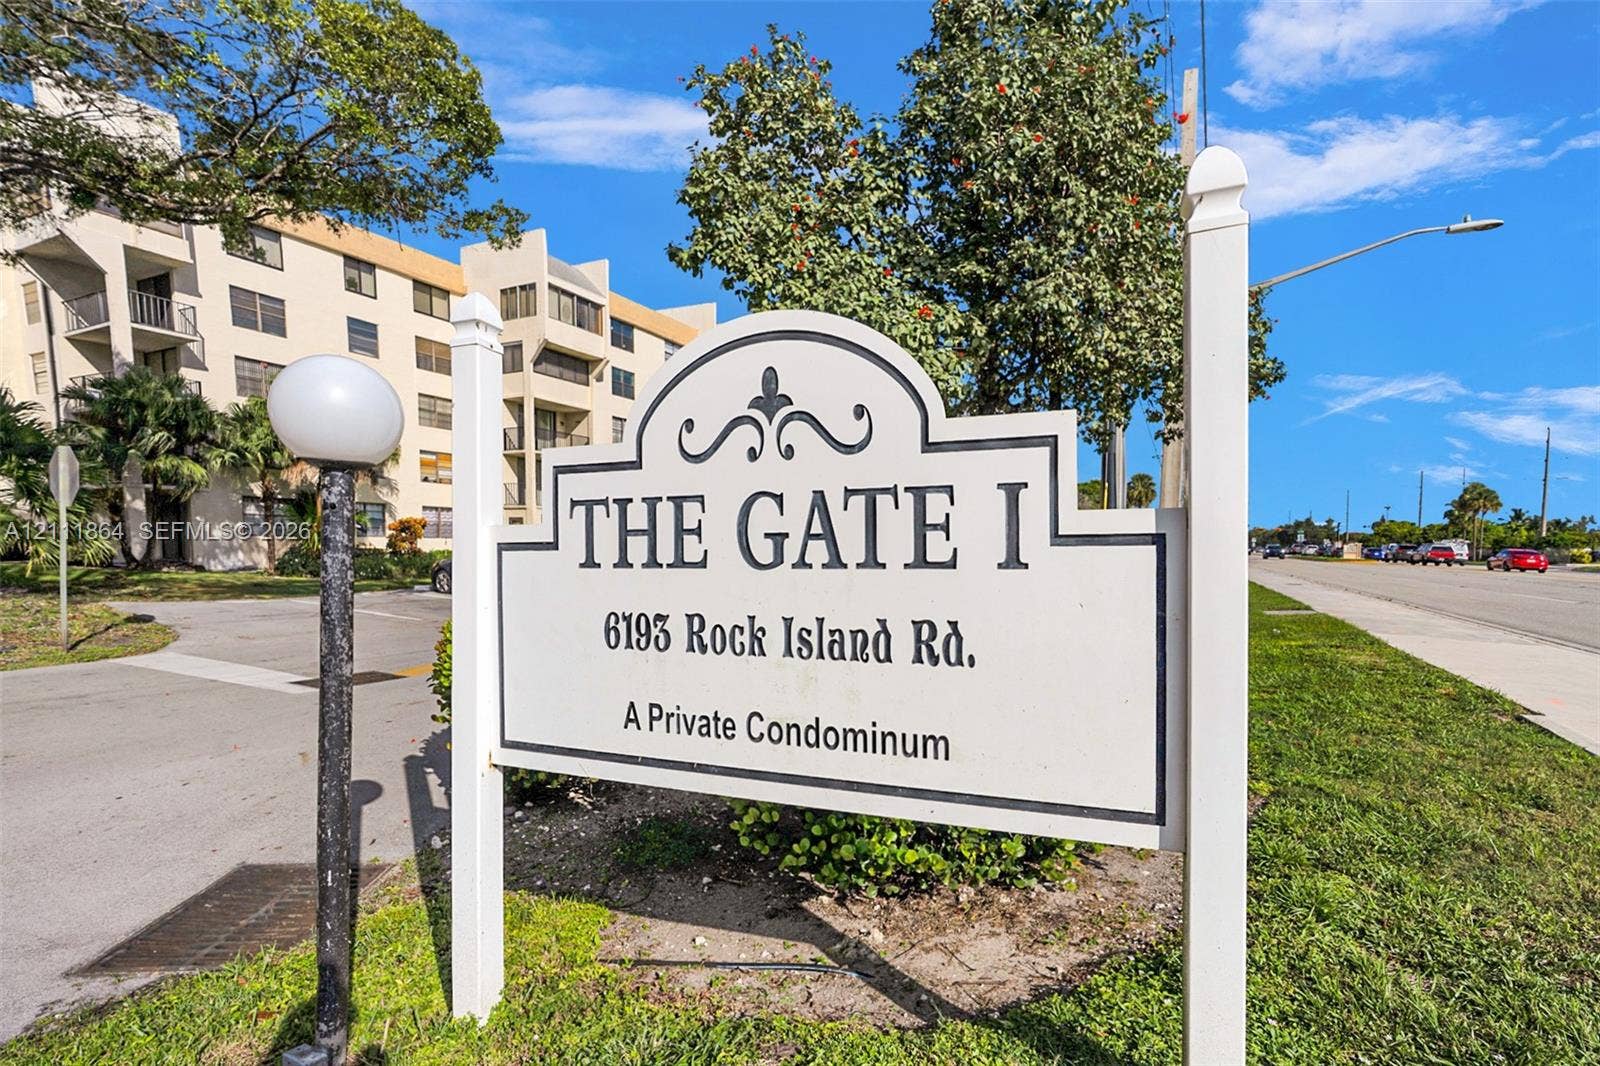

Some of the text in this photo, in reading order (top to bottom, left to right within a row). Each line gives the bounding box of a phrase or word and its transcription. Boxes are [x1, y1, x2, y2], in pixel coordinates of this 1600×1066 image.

[570, 481, 1029, 571] THE GATE I
[603, 611, 977, 669] 6193 Rock Island Rd.
[623, 700, 951, 762] A Private Condominum
